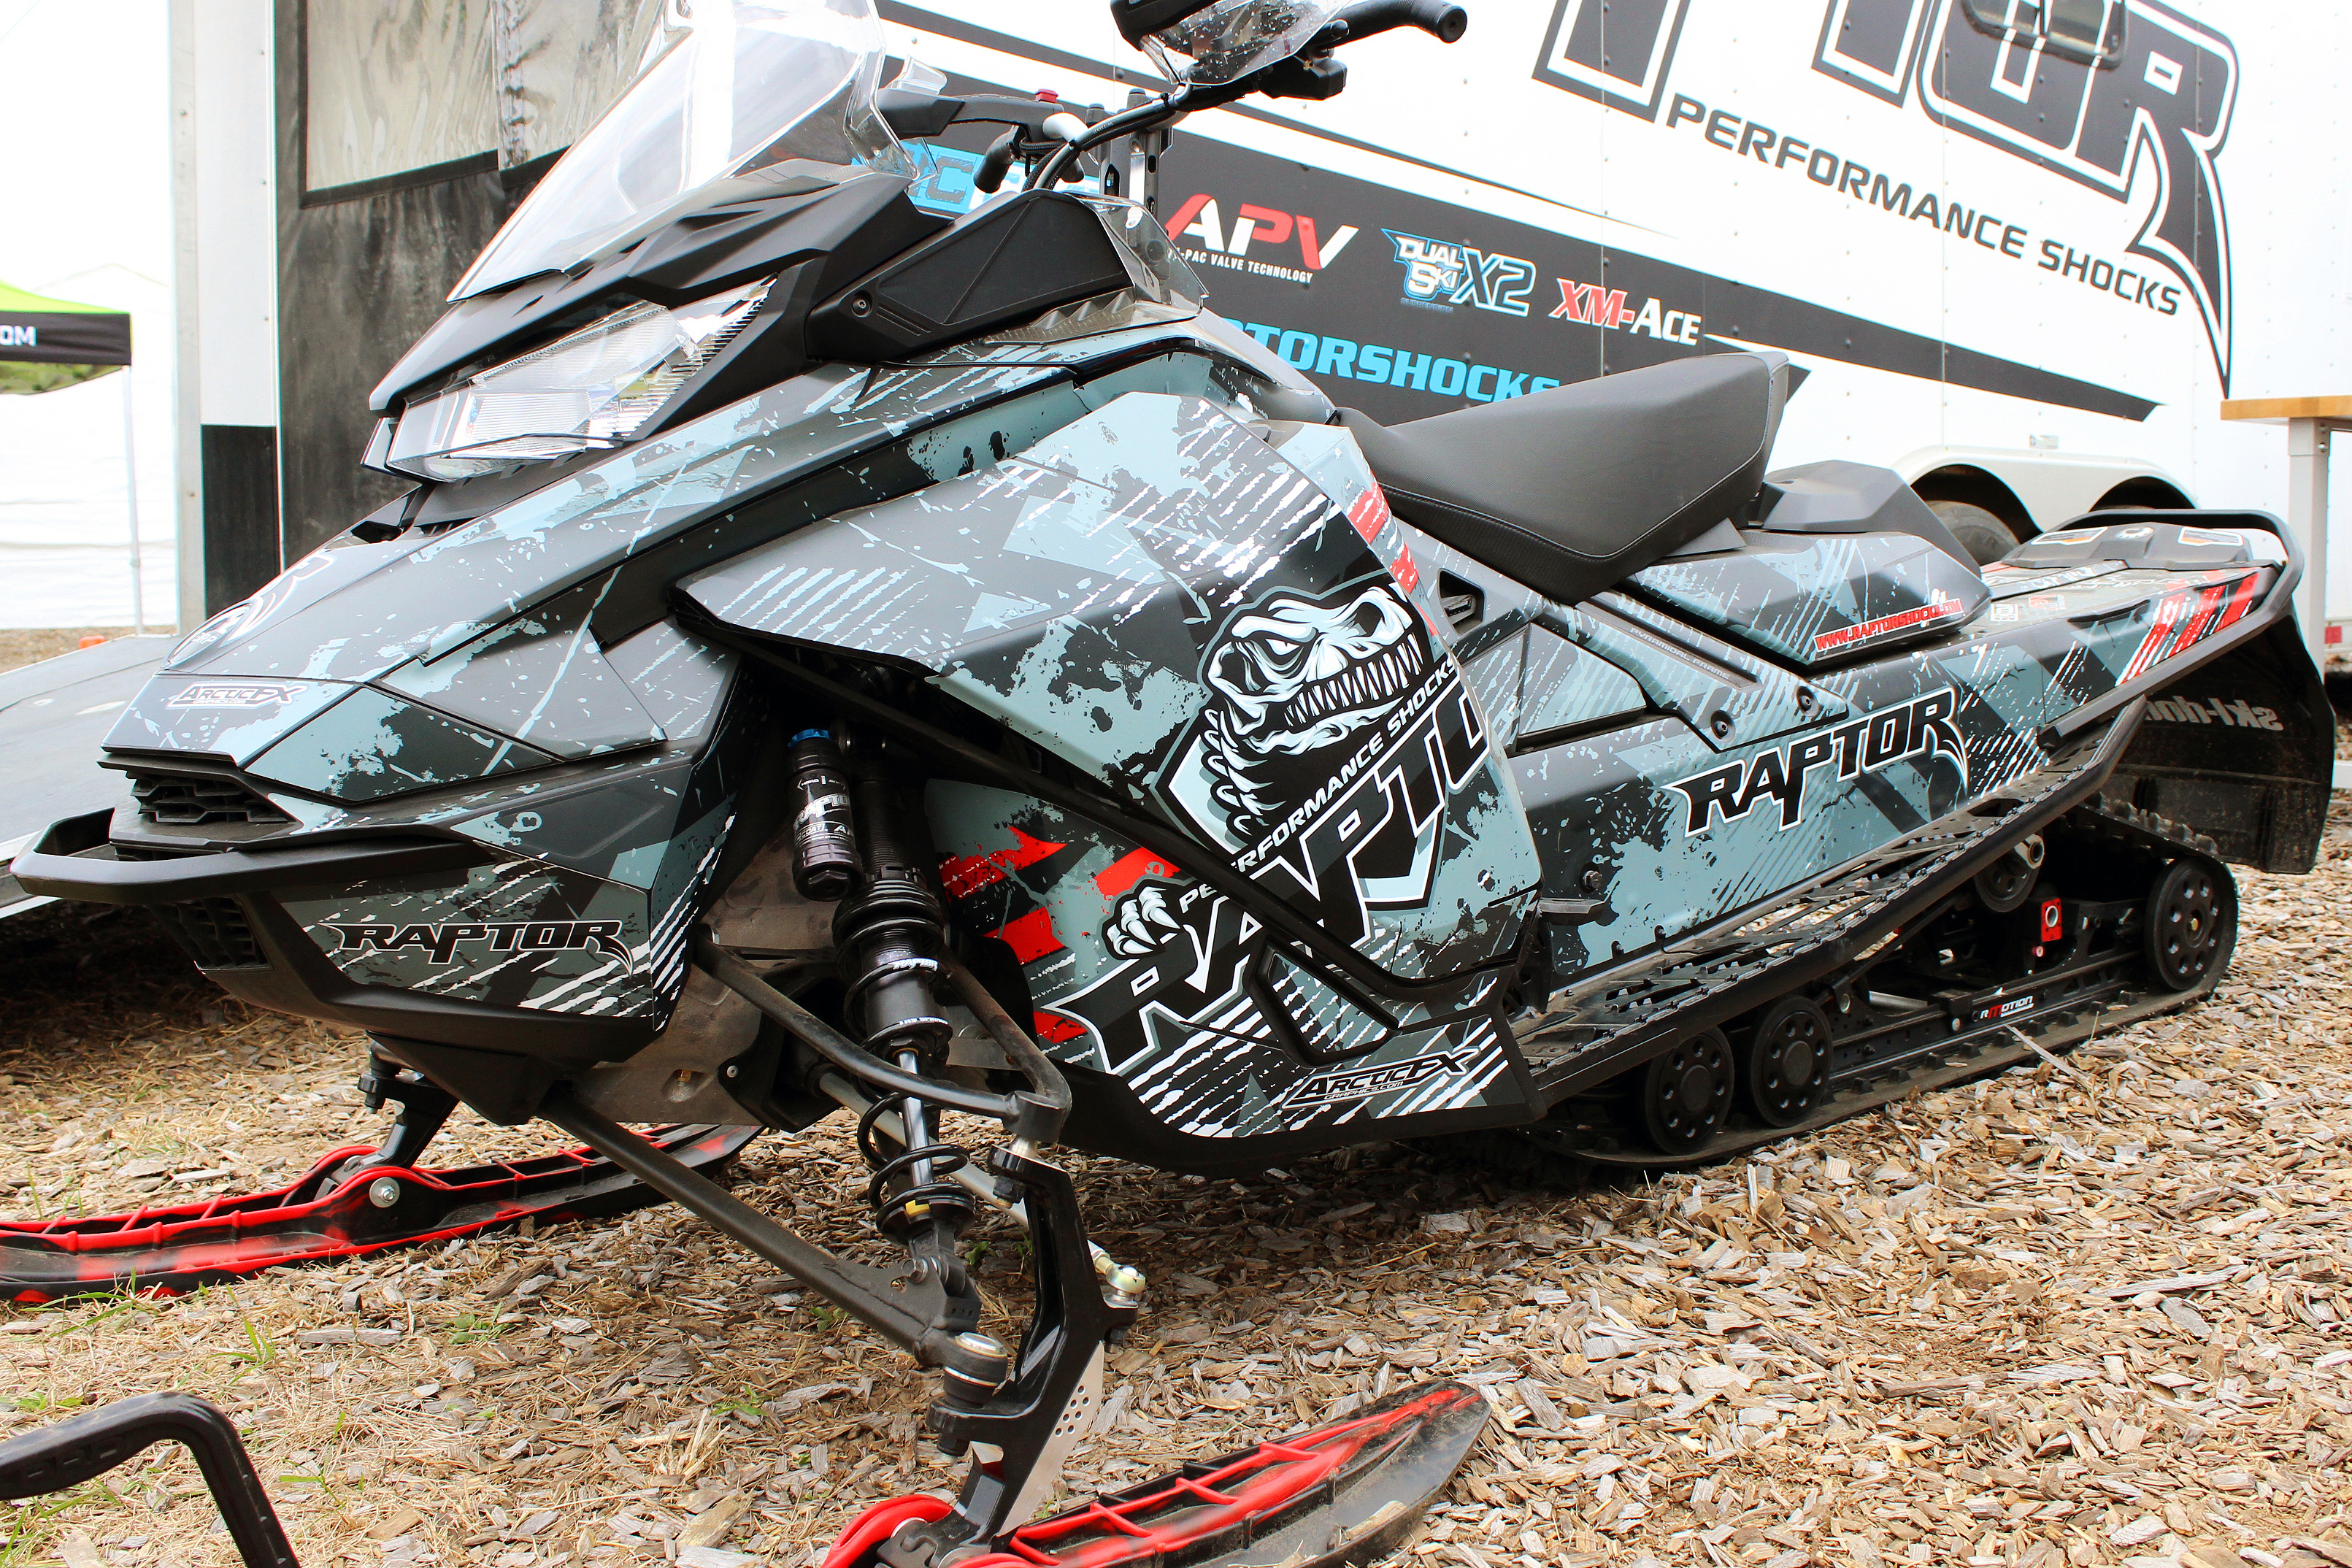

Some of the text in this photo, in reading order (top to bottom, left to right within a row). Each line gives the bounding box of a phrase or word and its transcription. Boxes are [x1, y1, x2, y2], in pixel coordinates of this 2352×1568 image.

[1164, 193, 1359, 270] APV
[1667, 93, 2181, 316] PERFORMANCE SHOCKS
[1210, 253, 1245, 271] VALVE
[1248, 260, 1314, 285] TECHNOLOGY
[1395, 236, 1464, 269] DUAL
[1448, 245, 1537, 318] X2
[1814, 599, 1962, 650] WWW.RAPTORSHOCKS.COM
[1629, 627, 1731, 680] PYRAMIDAL FRAME
[1660, 685, 1969, 838] RAPTOR
[318, 919, 634, 979] RAPTOR
[1323, 1080, 1404, 1101] GRAPHICS.COM
